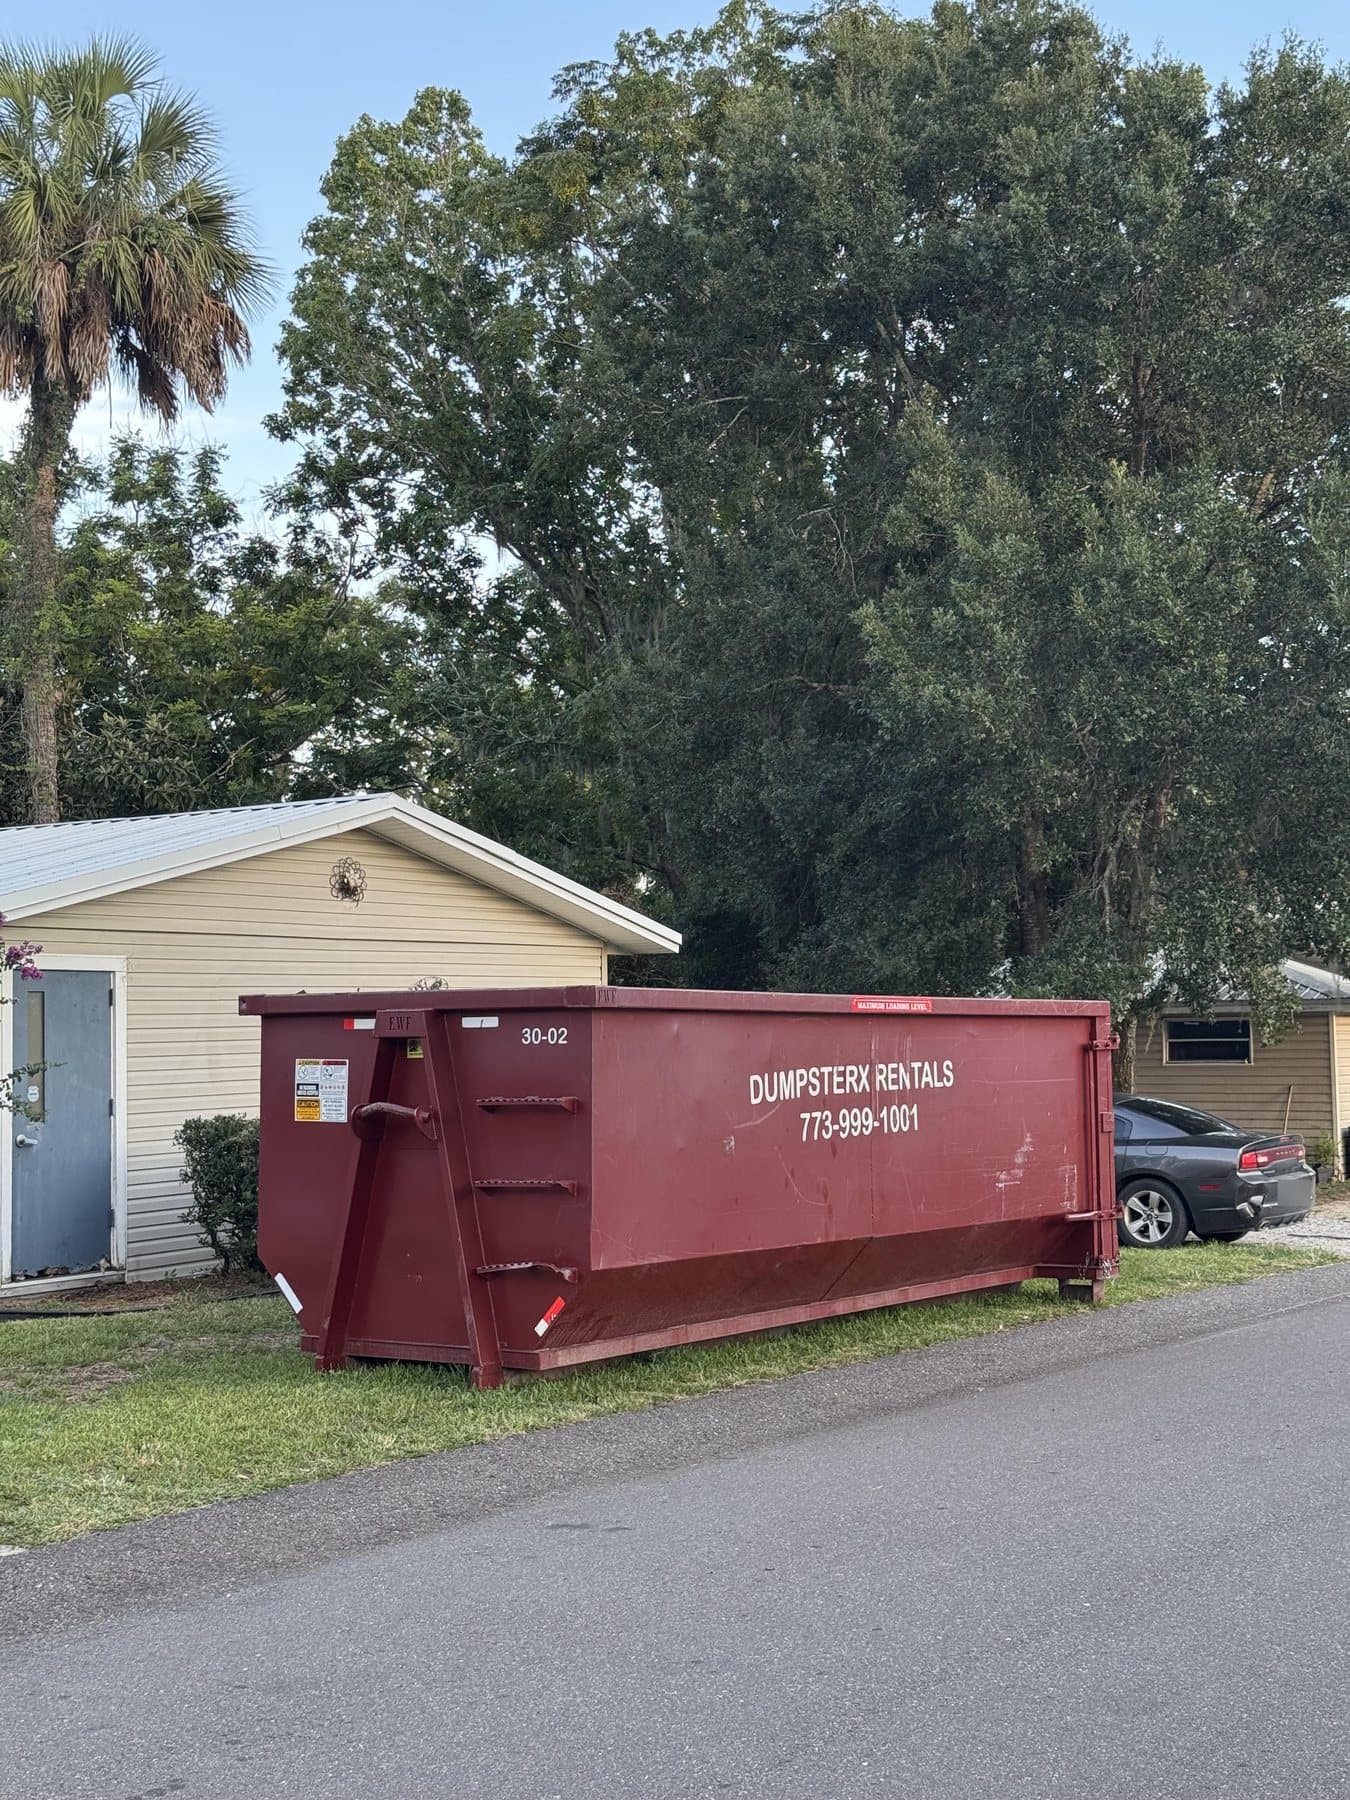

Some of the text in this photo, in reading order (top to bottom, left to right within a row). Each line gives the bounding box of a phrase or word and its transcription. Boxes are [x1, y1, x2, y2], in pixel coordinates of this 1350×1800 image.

[857, 1002, 885, 1010] MAXIMUM
[389, 1016, 411, 1031] EWF
[521, 1027, 568, 1044] 30-02
[750, 1060, 954, 1105] DUMPSTERX RENTALS
[800, 1103, 918, 1142] 773-999-1001
